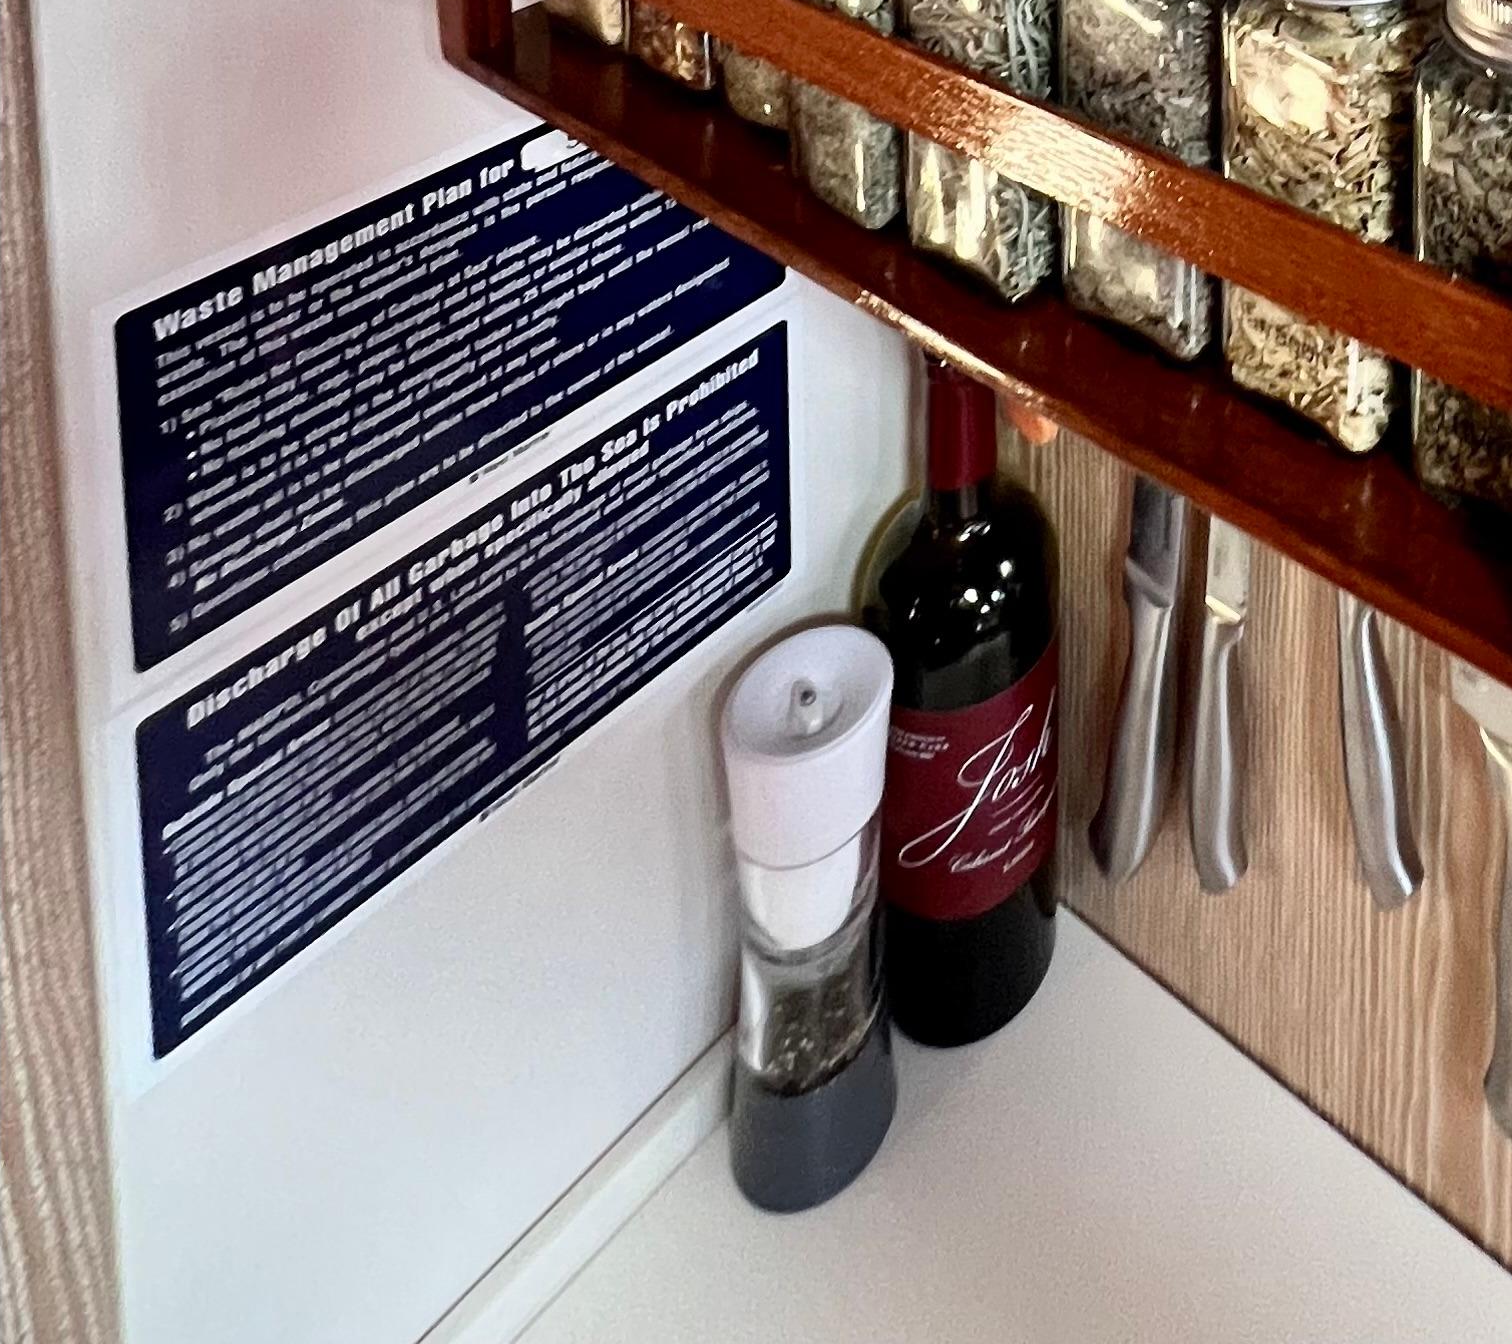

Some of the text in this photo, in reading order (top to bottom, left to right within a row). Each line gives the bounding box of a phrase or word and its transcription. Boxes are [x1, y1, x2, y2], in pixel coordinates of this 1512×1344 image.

[153, 286, 243, 341] Waste
[253, 203, 414, 295] Management
[422, 178, 472, 216] Plan
[479, 158, 515, 189] for
[187, 627, 326, 729] Discharge
[334, 599, 361, 633] Of
[369, 575, 401, 612] All
[408, 514, 504, 585] Garbage
[510, 483, 552, 521] Into
[559, 455, 595, 489] The
[600, 429, 638, 463] Sea
[642, 413, 661, 437] Is
[666, 348, 759, 421] Prohibited
